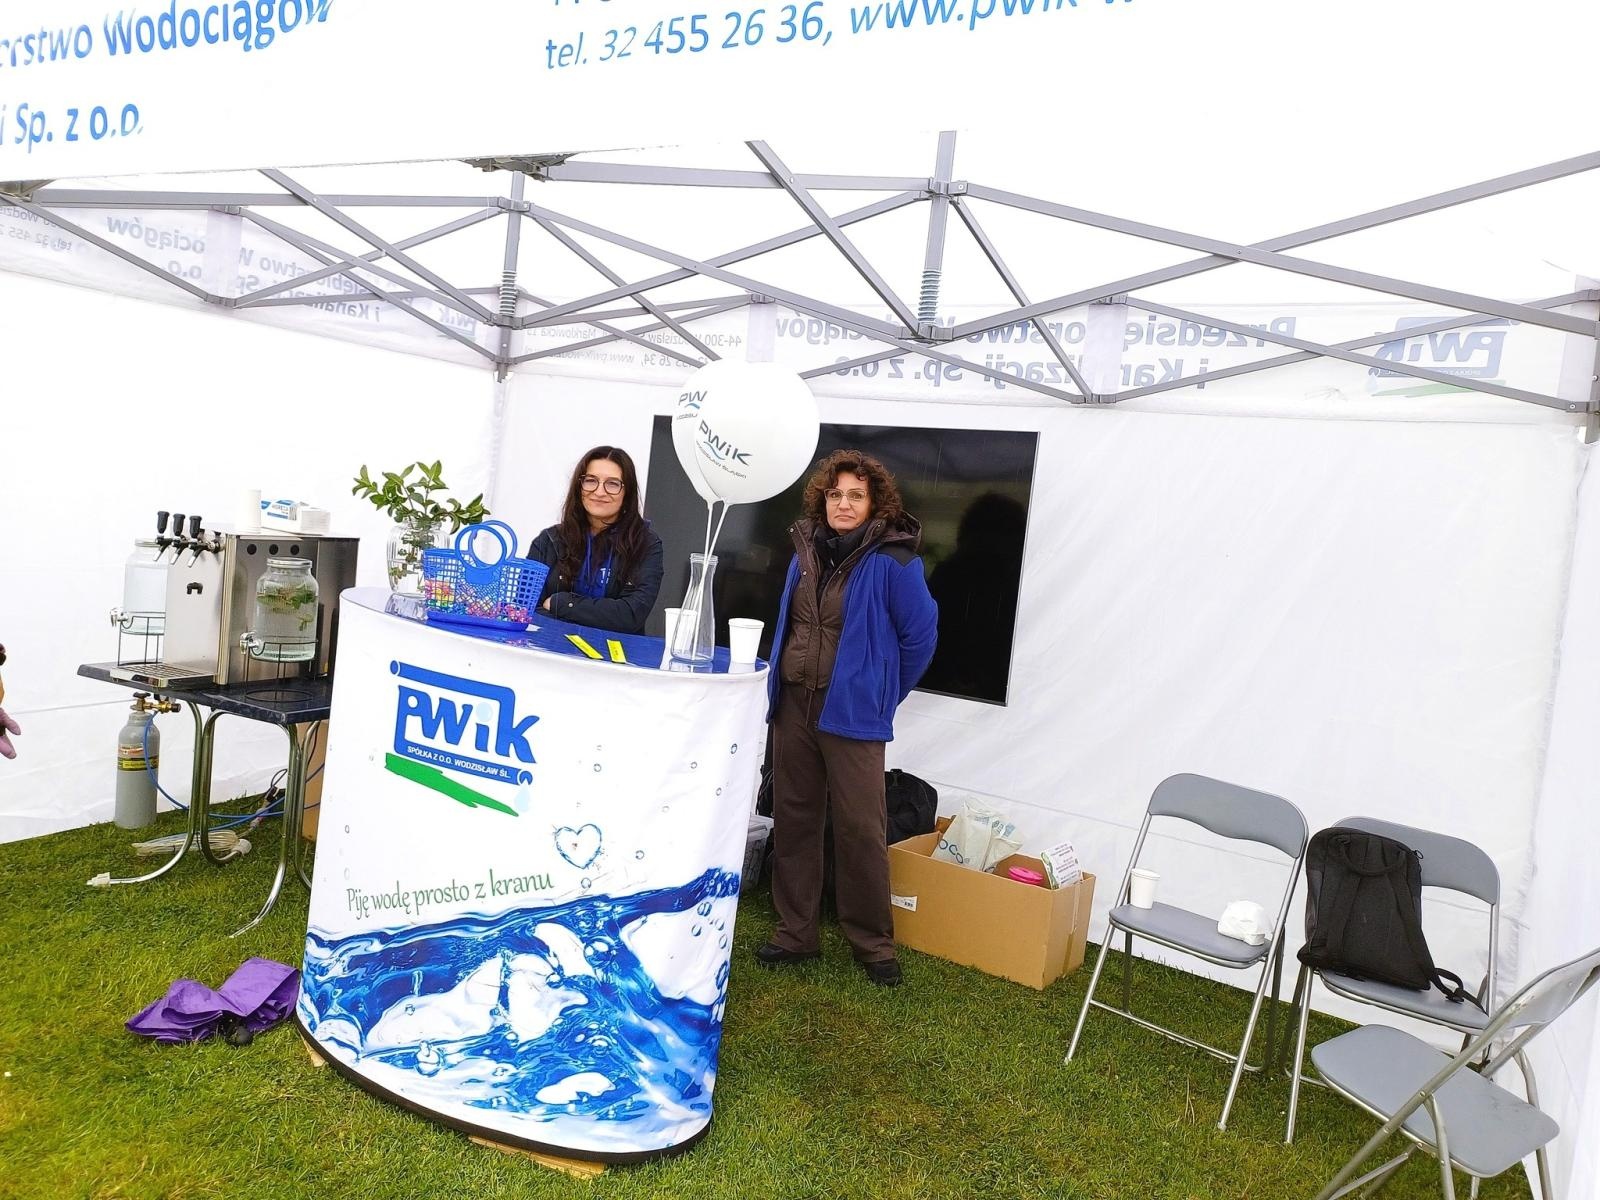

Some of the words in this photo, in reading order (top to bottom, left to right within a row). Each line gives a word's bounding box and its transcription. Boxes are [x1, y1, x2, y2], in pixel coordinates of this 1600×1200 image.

[545, 31, 588, 69] tel.
[599, 26, 637, 61] 32
[643, 14, 709, 54] 455
[722, 9, 766, 49] 26
[776, 1, 832, 46] 36,
[14, 102, 53, 154] Sp.
[65, 108, 79, 142] z
[89, 103, 144, 141] o.o.
[407, 745, 433, 760] SPÓŁKA
[439, 755, 453, 765] O.O.
[454, 758, 498, 776] WODZISŁAW
[346, 887, 370, 921] Piję
[371, 880, 412, 915] wodę
[412, 879, 471, 916] prosto
[474, 882, 487, 900] z
[488, 868, 555, 897] kranu
